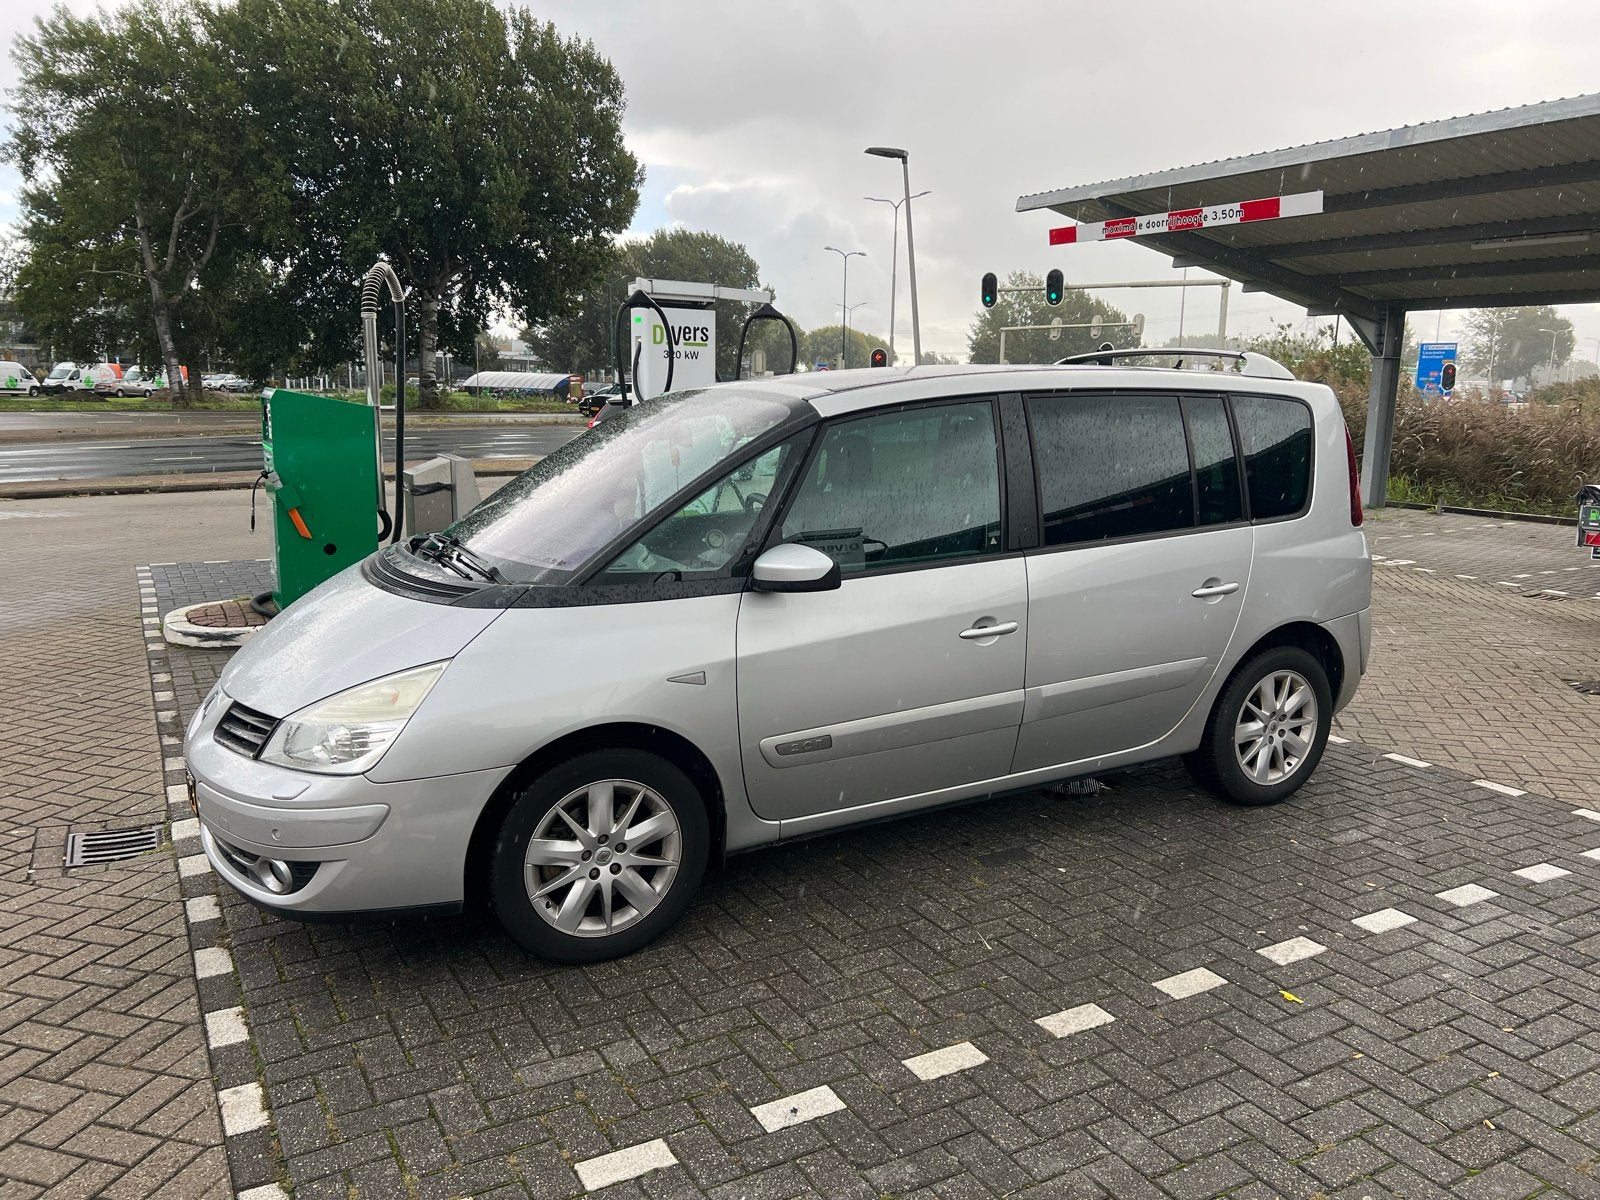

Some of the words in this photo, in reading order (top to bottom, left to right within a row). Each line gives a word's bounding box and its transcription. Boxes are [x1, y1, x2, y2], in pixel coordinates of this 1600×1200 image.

[1102, 222, 1143, 235] maximale
[1212, 208, 1244, 221] 3.50m
[652, 324, 709, 346] DVers
[684, 350, 700, 360] kW
